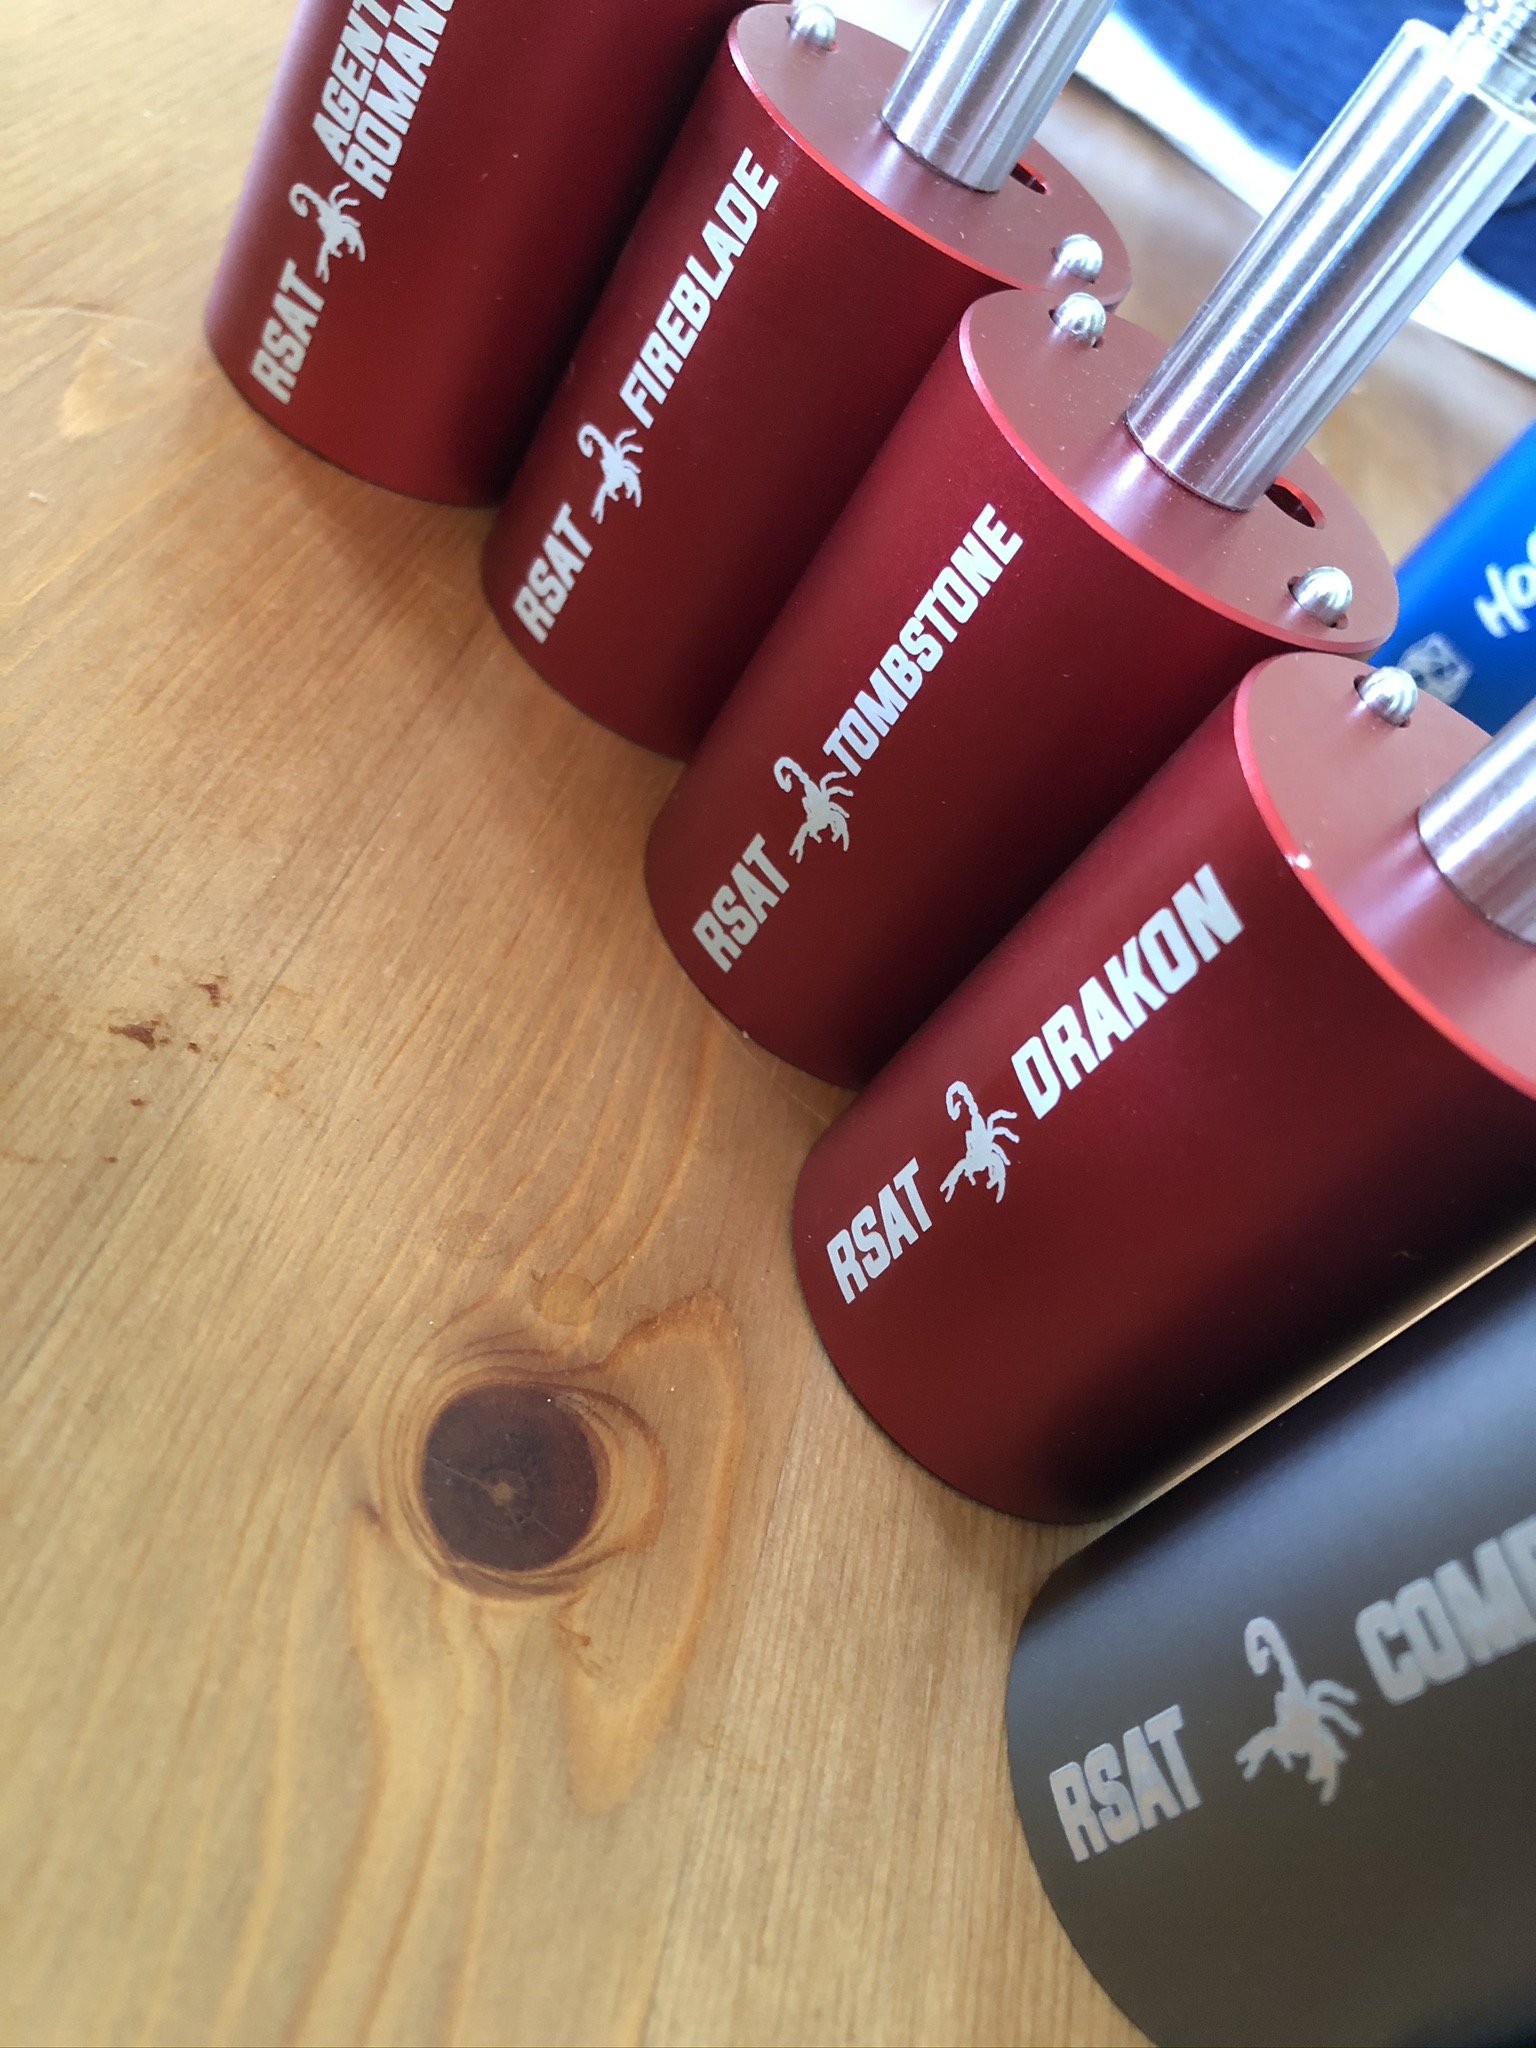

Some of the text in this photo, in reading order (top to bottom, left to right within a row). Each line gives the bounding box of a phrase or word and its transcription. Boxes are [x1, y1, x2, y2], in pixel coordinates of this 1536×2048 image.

[312, 0, 393, 166] AGENT
[343, 0, 455, 200] ROMAN
[250, 258, 325, 404] RSAT
[512, 146, 780, 645] RSAT FIREBLADE
[692, 502, 1024, 973] RSAT TOMBSTONE
[826, 863, 1244, 1305] RSAT DRAKON
[1048, 1703, 1202, 1863] RSAT
